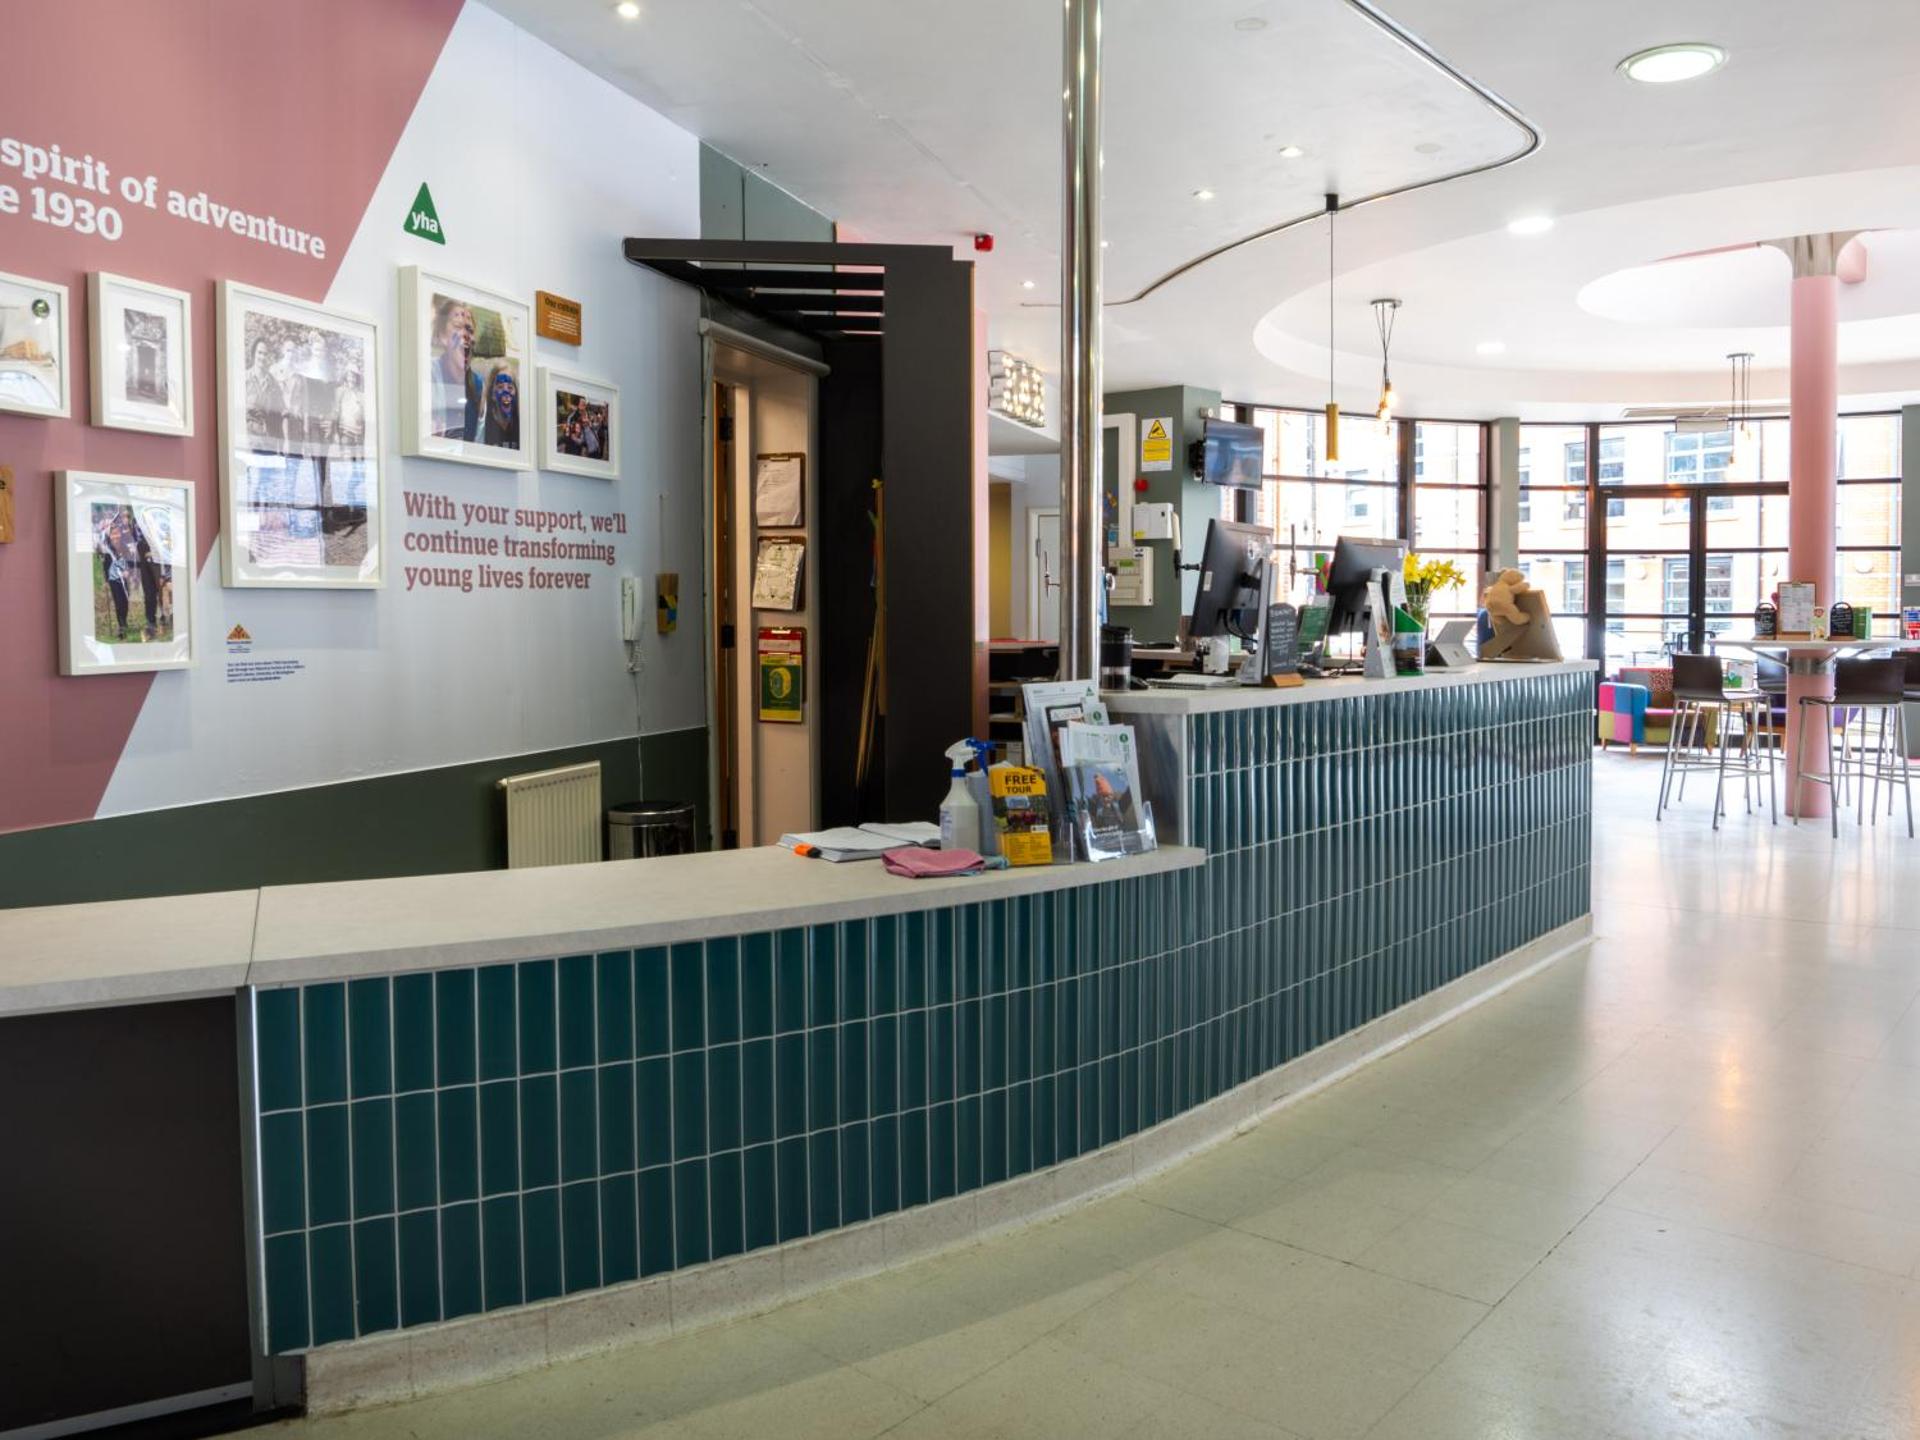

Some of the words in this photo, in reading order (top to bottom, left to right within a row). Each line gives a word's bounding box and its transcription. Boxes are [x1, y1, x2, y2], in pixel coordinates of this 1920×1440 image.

[0, 137, 110, 195] spirit
[120, 175, 157, 209] of
[166, 191, 326, 259] adventure
[31, 186, 123, 241] 1930
[411, 210, 439, 233] yha
[403, 491, 456, 520] With
[462, 502, 510, 527] your
[514, 508, 587, 533] support,
[591, 512, 627, 534] we'll
[403, 530, 499, 556] continue
[504, 535, 615, 566] transforming
[404, 565, 473, 593] young
[478, 564, 523, 589] lives
[529, 566, 591, 589] forever
[1004, 774, 1037, 785] FREE
[1005, 786, 1032, 794] TOUR
